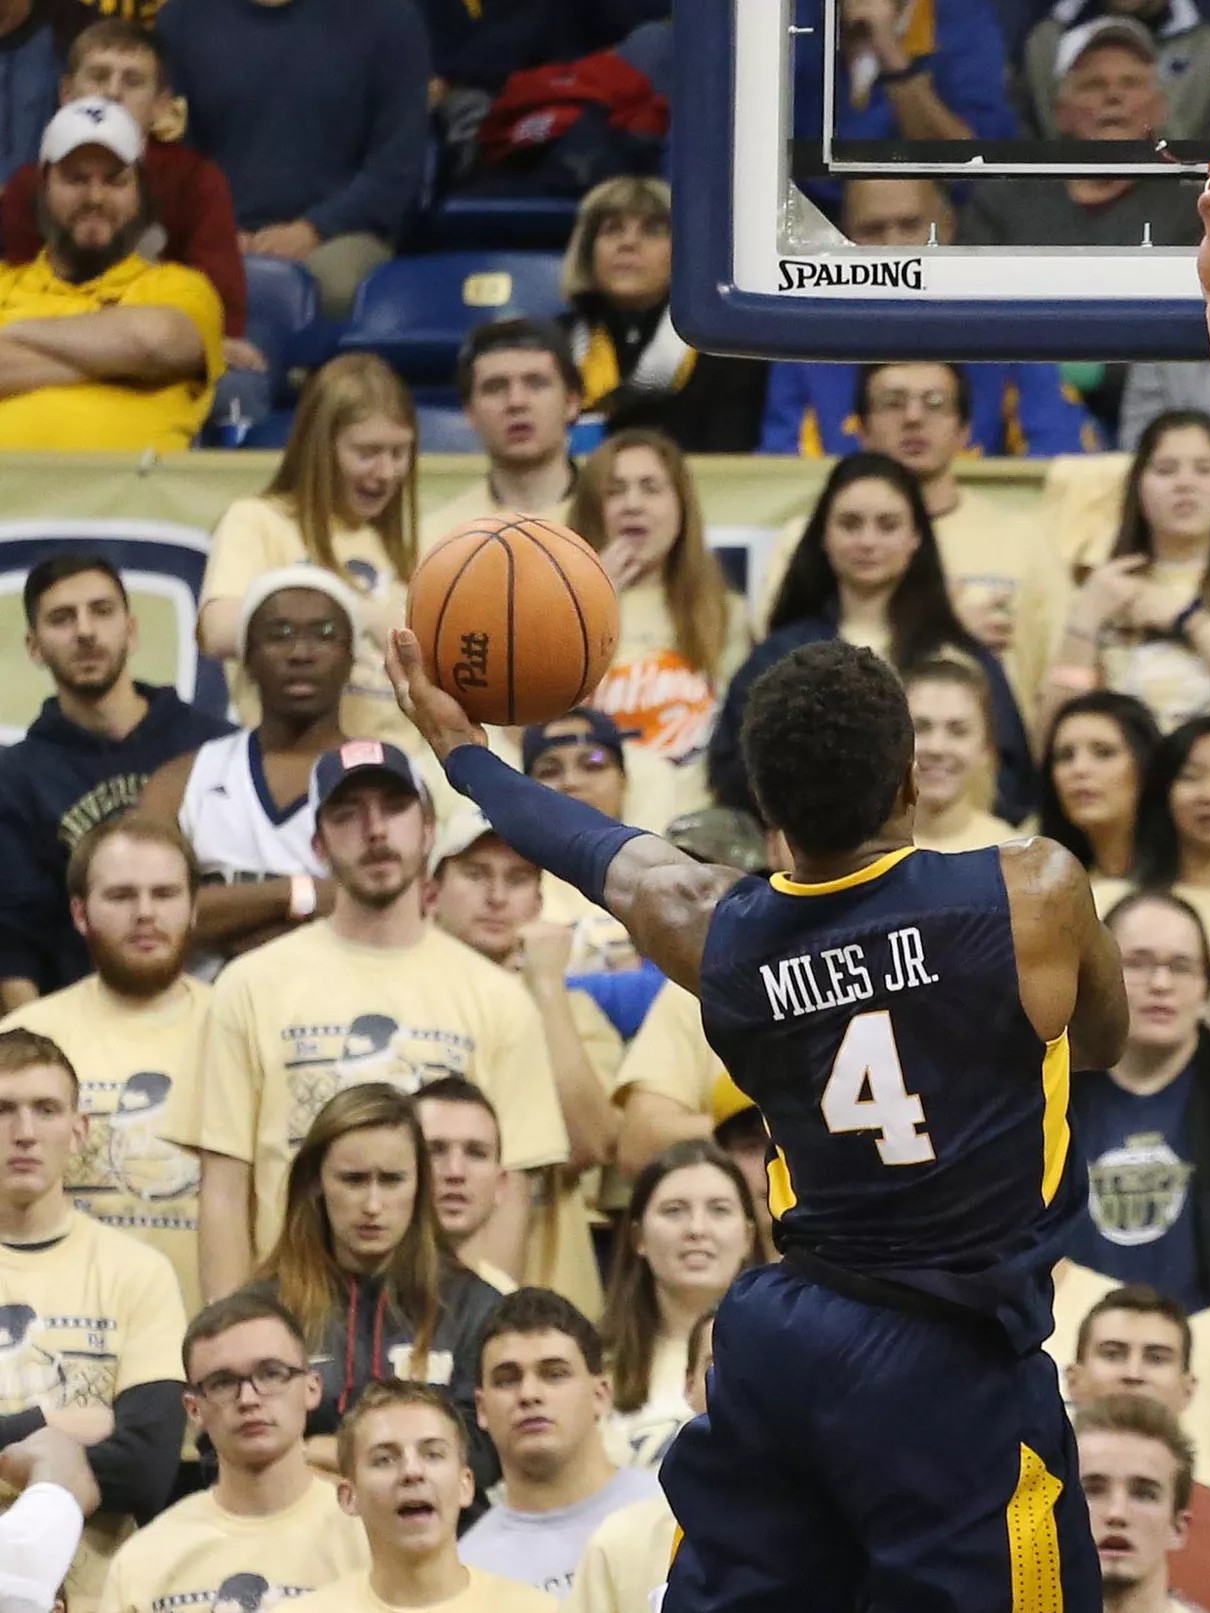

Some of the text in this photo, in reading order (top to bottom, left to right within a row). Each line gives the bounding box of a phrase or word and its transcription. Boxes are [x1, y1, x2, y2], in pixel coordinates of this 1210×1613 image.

[779, 258, 922, 291] SPALDING
[453, 632, 489, 692] Pitt
[760, 927, 939, 1021] MILES JR.
[820, 1009, 936, 1166] 4
